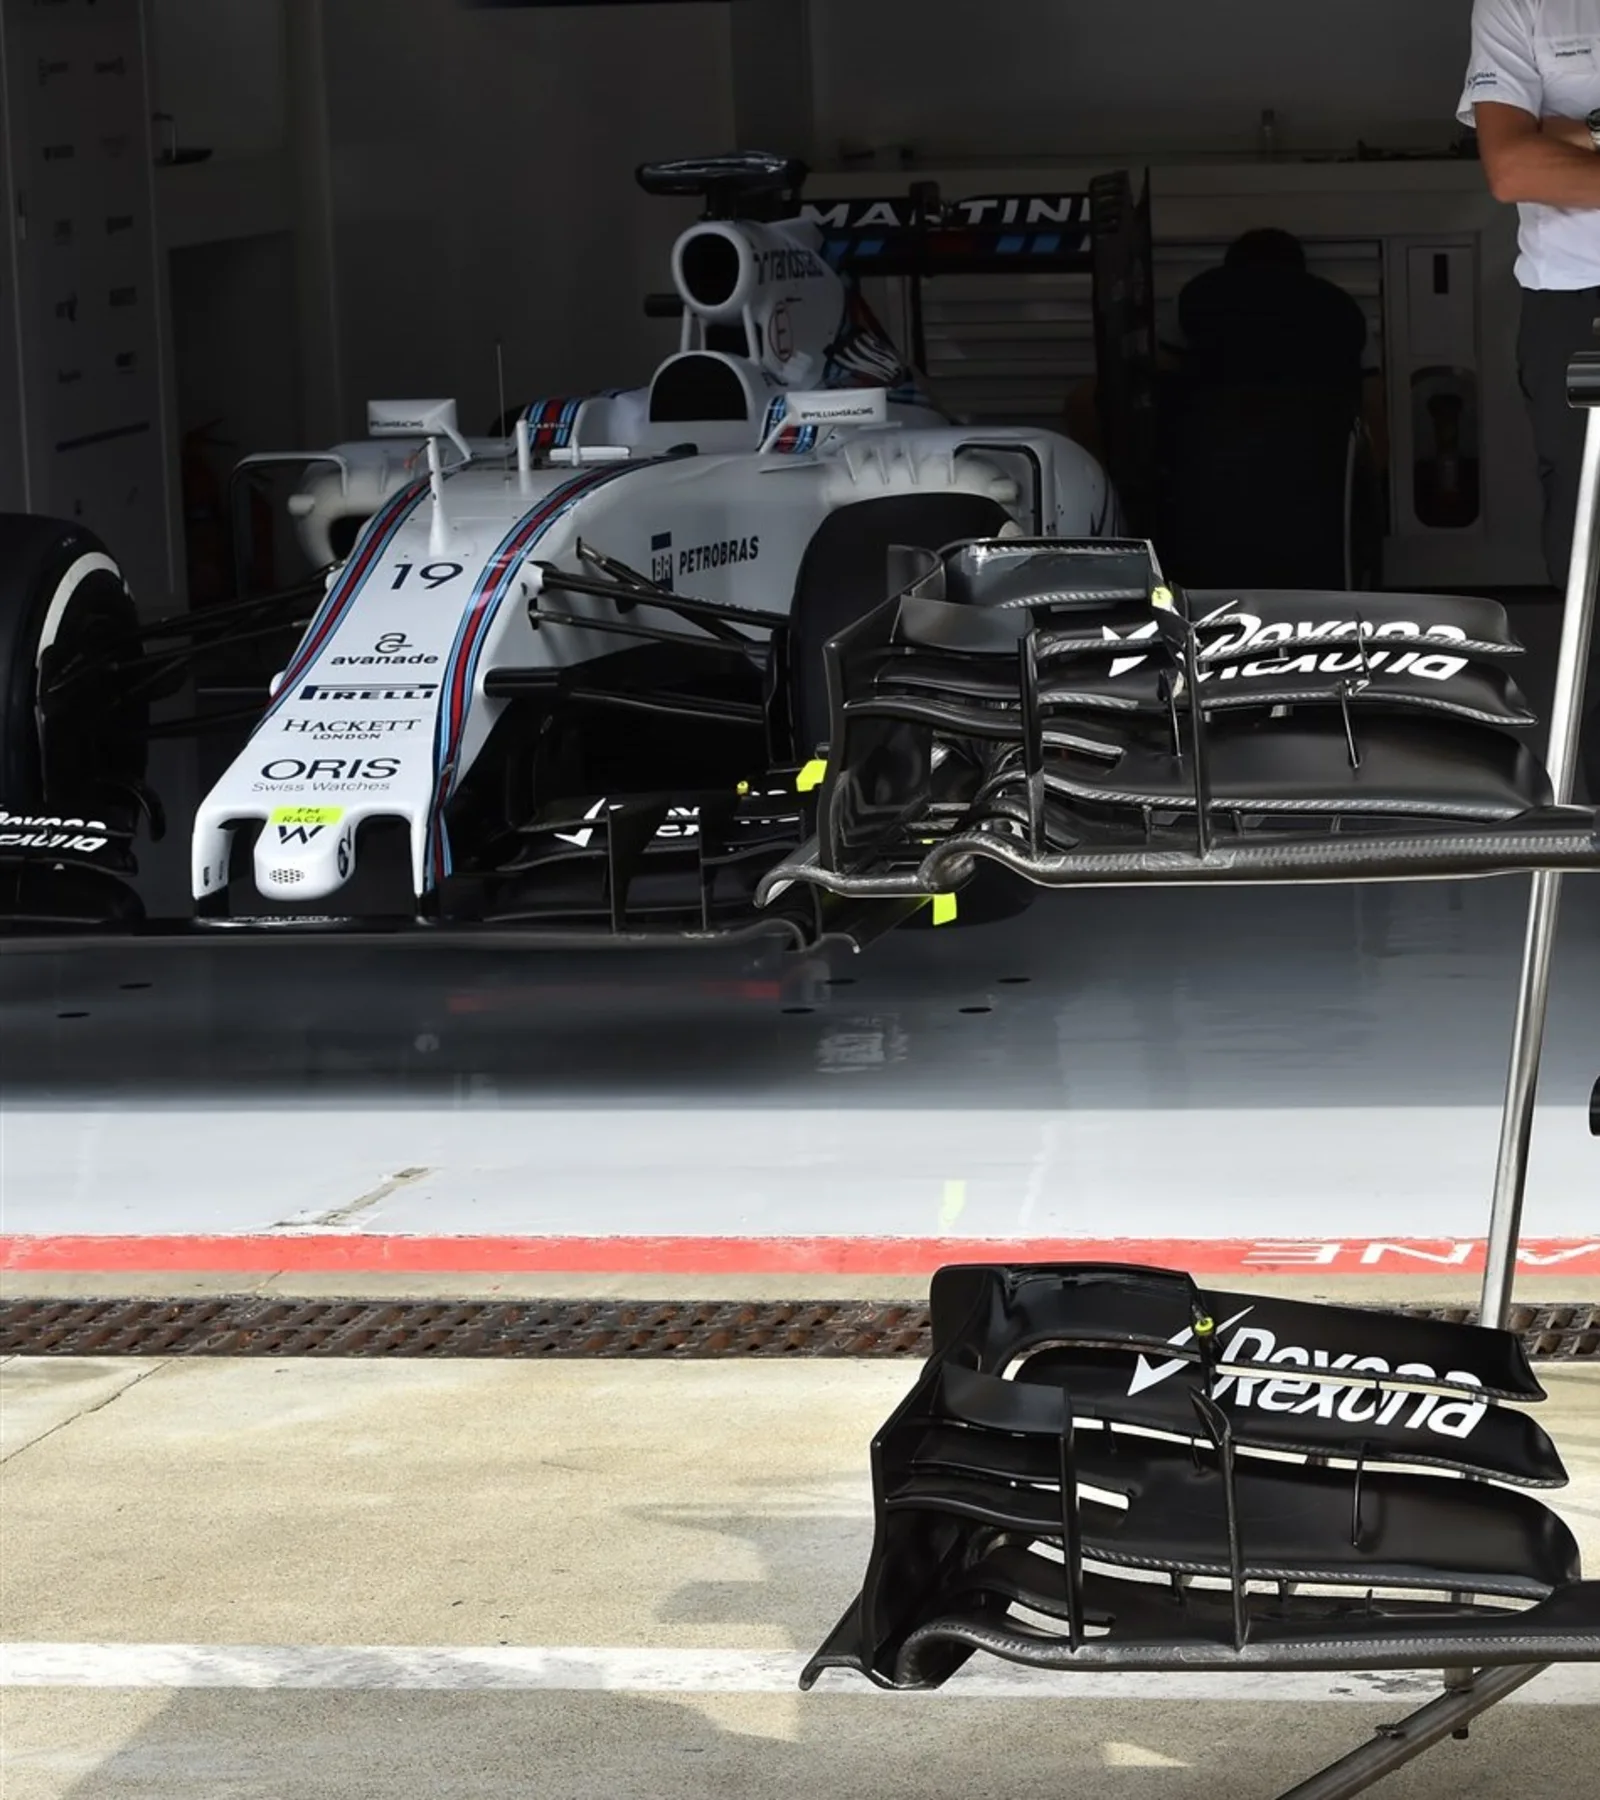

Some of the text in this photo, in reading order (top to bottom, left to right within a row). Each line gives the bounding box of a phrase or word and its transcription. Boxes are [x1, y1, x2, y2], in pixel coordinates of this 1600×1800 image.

[679, 536, 759, 575] PETROBRAS
[390, 562, 463, 589] 19
[331, 654, 438, 665] avanade
[299, 684, 438, 700] PIRELLI
[282, 719, 421, 732] HACKETT
[261, 758, 401, 780] ORIS
[252, 781, 390, 792] Swiss Watches
[282, 815, 325, 823] RACE
[1220, 1327, 1487, 1439] Rexona
